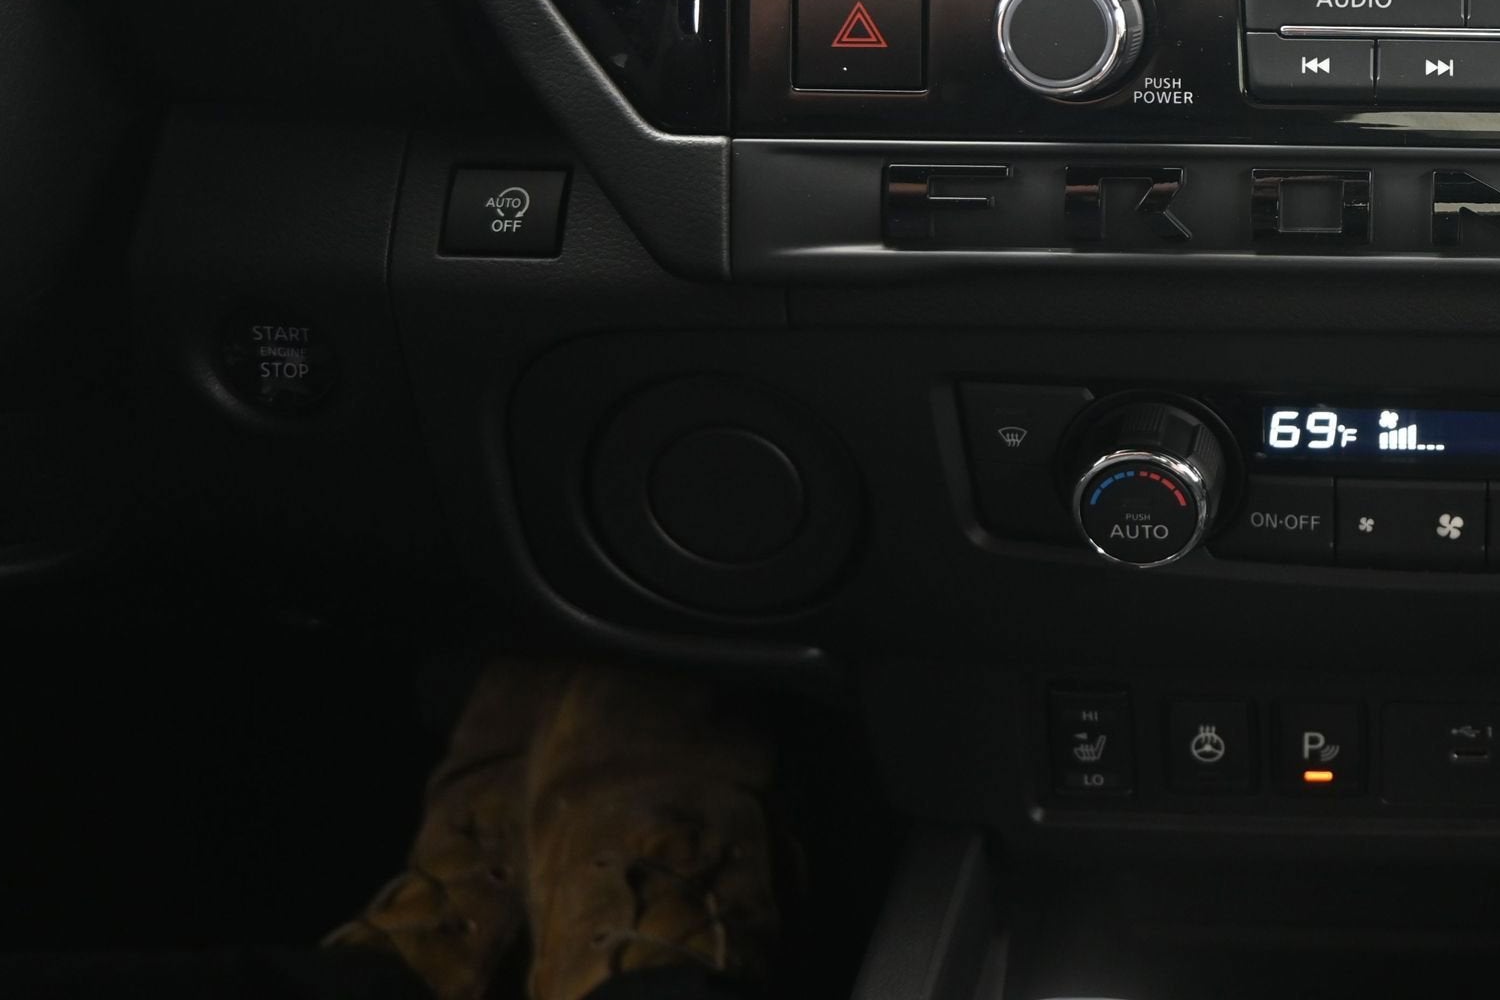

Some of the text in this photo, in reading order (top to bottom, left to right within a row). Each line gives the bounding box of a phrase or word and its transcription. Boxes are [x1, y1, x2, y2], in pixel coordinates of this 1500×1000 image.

[1143, 76, 1183, 90] PUSH
[1132, 89, 1194, 105] POWER
[485, 196, 522, 209] AUTO
[491, 219, 522, 232] OFF
[251, 325, 310, 342] START
[259, 345, 307, 357] ENGINE
[259, 361, 309, 379] STOP
[1125, 512, 1151, 522] PUSH
[1109, 523, 1169, 541] AUTO
[1081, 710, 1099, 721] HI
[1485, 726, 1494, 739] 1
[1083, 774, 1105, 787] LO
